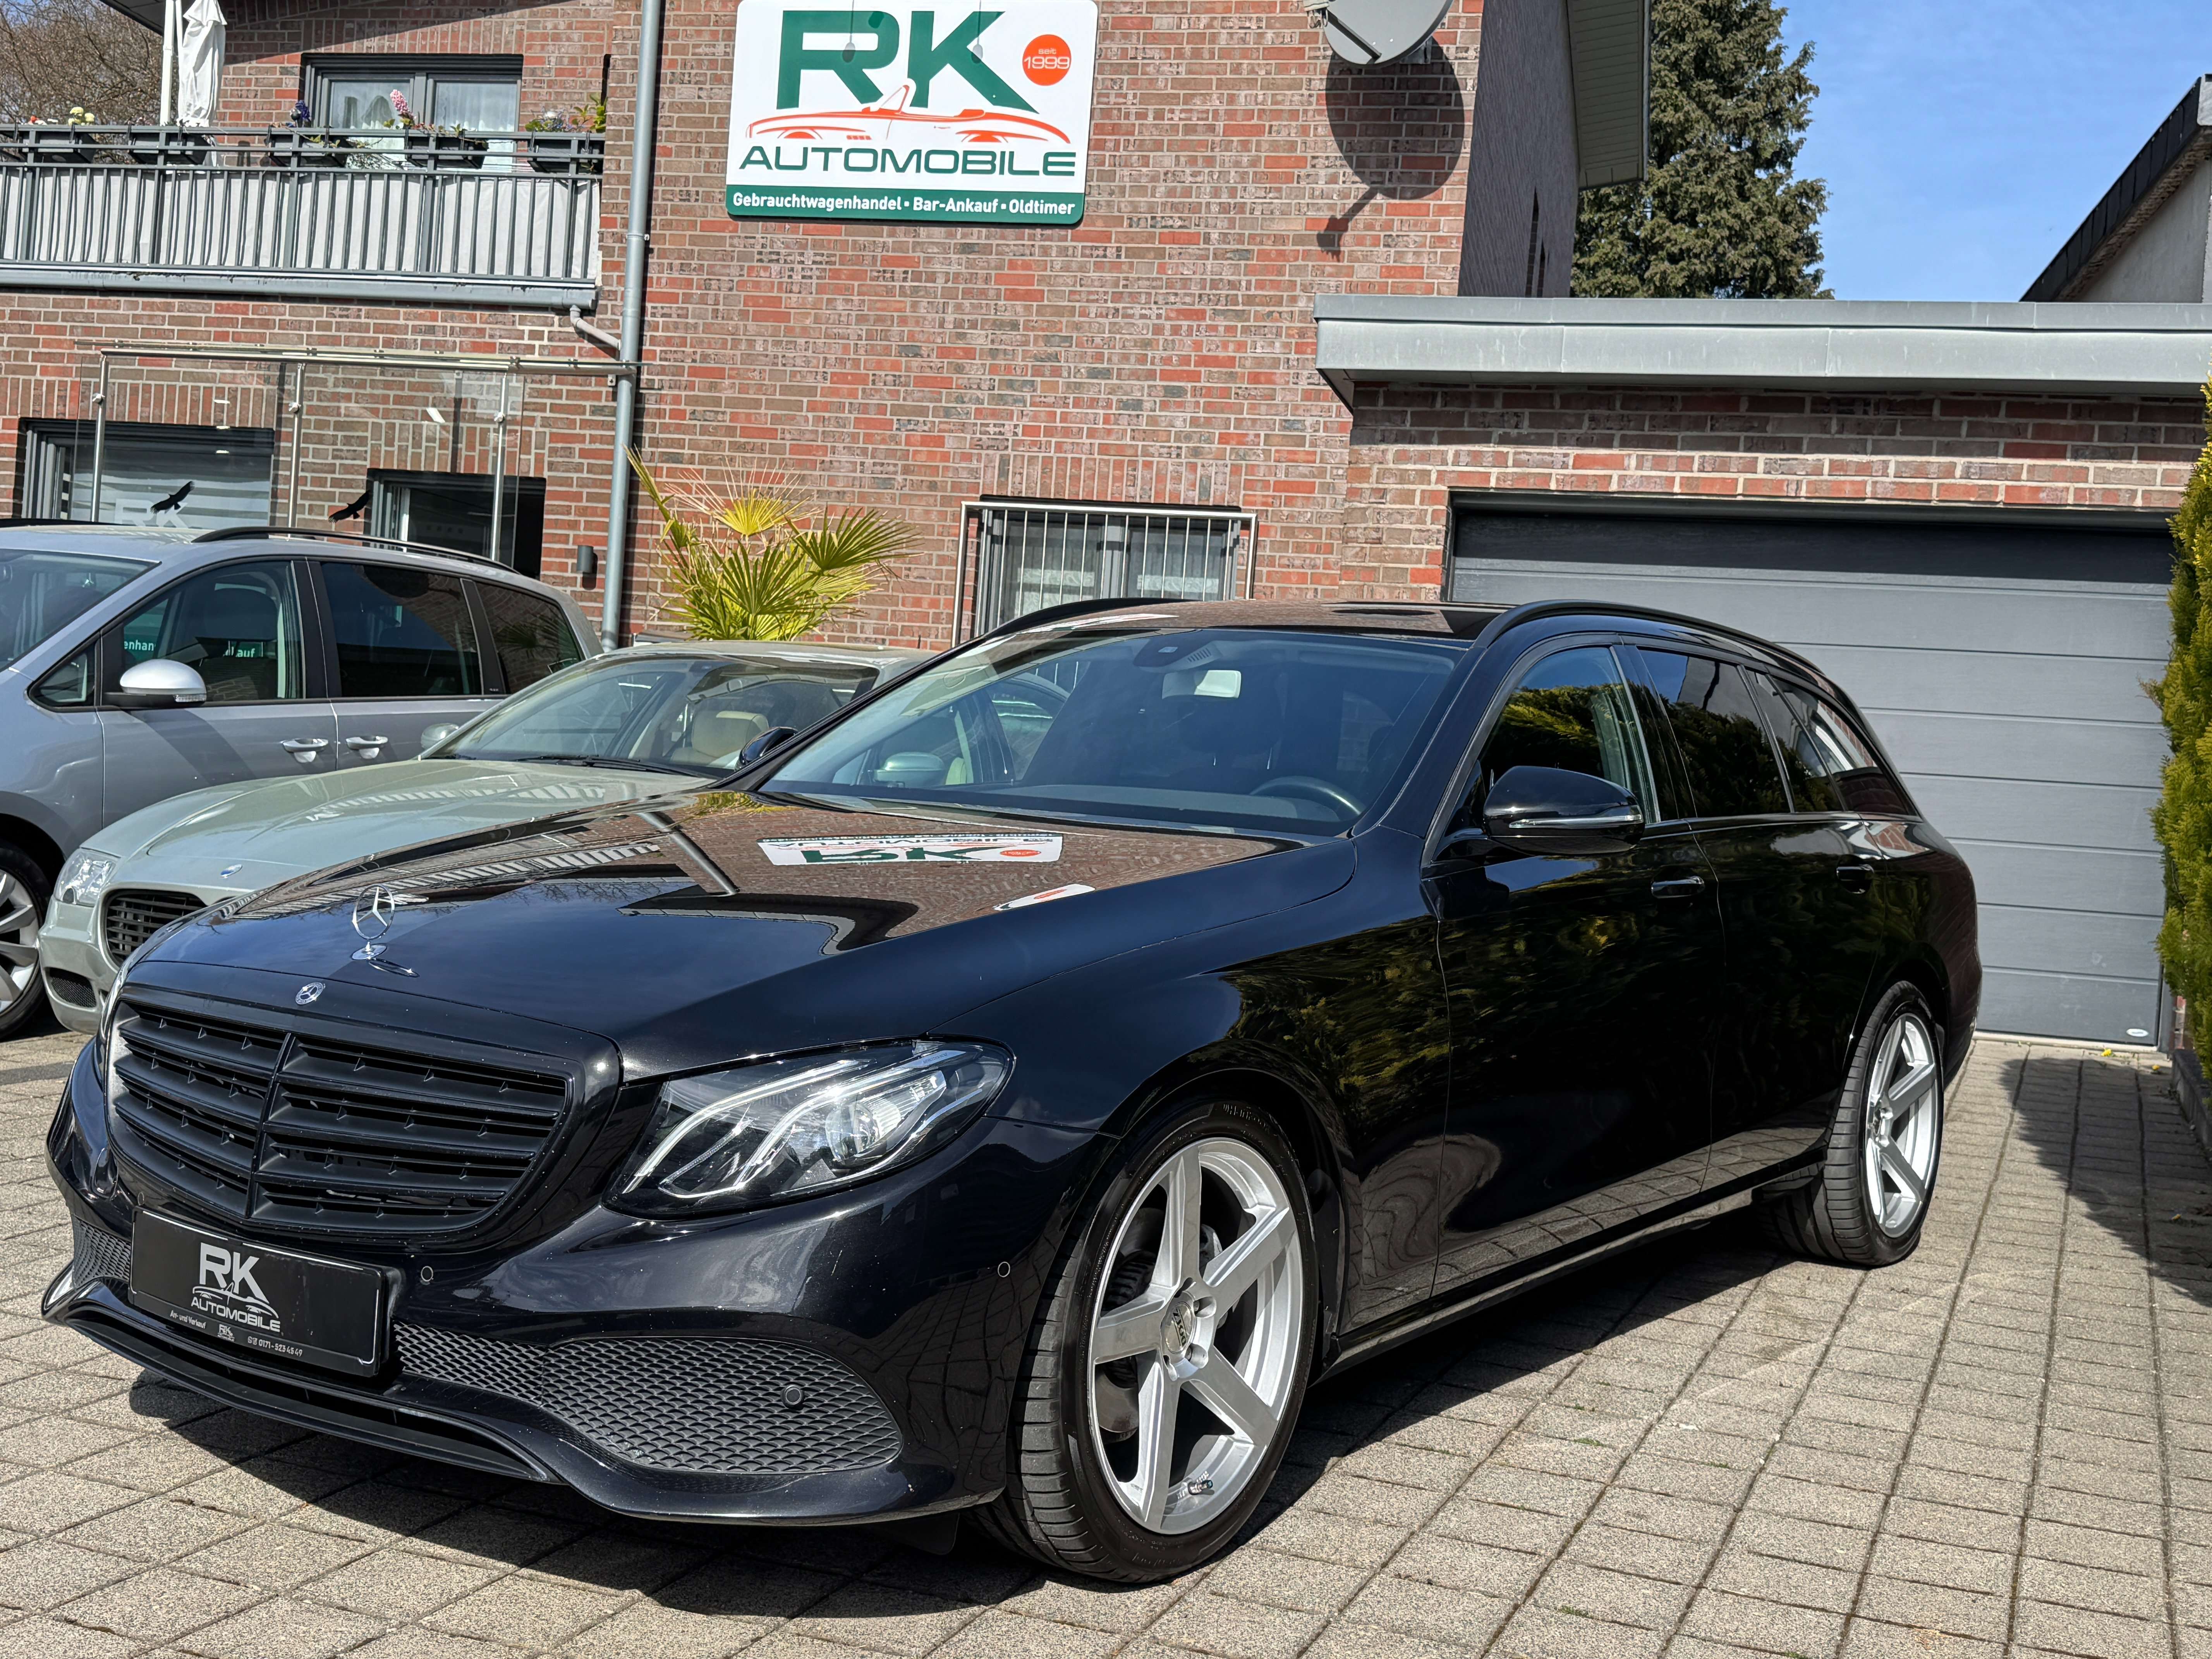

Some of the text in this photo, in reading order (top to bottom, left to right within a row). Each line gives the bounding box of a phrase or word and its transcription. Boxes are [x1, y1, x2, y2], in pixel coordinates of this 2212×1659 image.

[776, 10, 1039, 115] RK
[1024, 55, 1070, 70] 1999
[1038, 47, 1057, 55] seit
[738, 146, 1077, 177] AUTOMOBILE
[733, 192, 1075, 215] Gebrauchtwagenhandel Bar-Ankauf Oldtimer
[124, 639, 156, 651] enhan
[199, 1242, 269, 1304] RK
[191, 1296, 281, 1333] AUTOMOBILE
